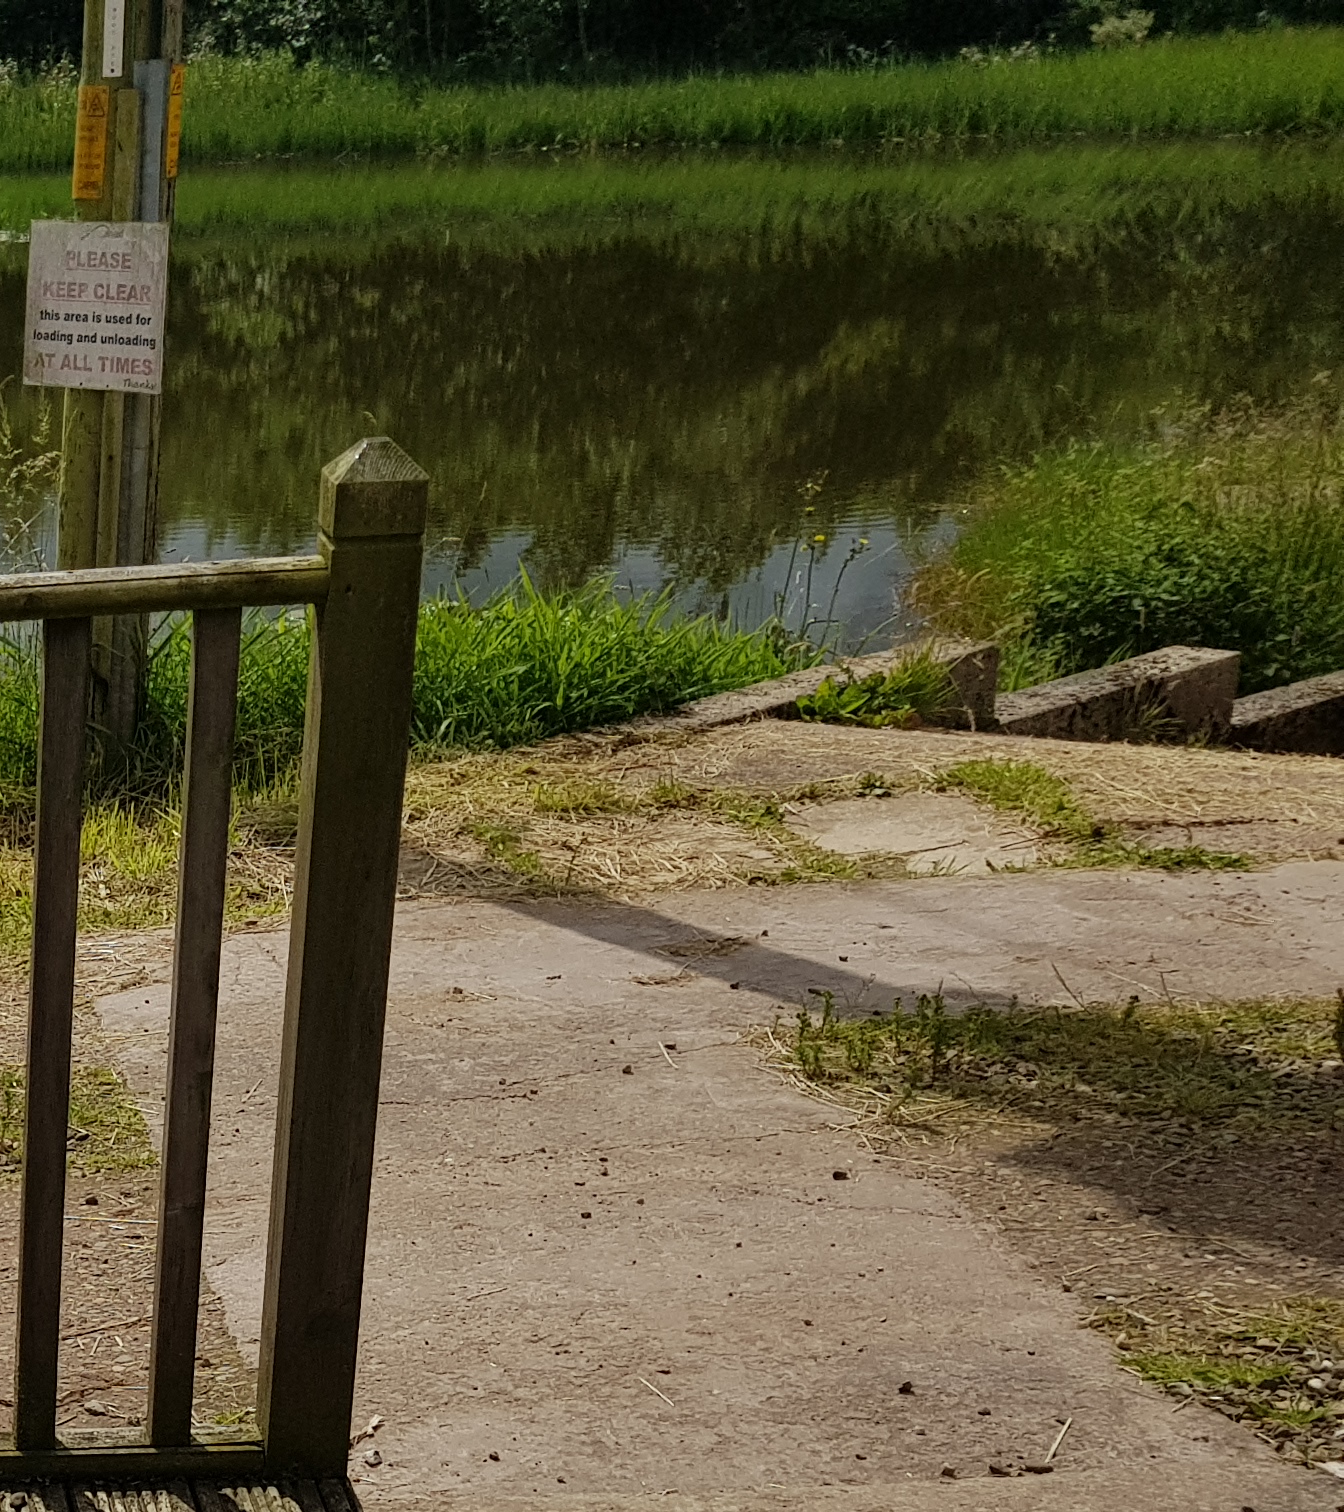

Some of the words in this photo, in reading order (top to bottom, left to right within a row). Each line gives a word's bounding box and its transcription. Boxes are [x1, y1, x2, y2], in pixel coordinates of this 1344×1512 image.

[66, 250, 132, 270] PLEASE
[42, 280, 88, 298] KEEP
[93, 283, 152, 302] CLEAR
[40, 309, 60, 321] this
[64, 312, 88, 322] area
[92, 311, 102, 323] is
[106, 314, 132, 325] used
[136, 314, 152, 325] for
[33, 329, 73, 345] loading
[77, 332, 97, 343] and
[101, 334, 156, 350] unloading
[34, 352, 56, 369] AT
[60, 353, 92, 372] ALL
[98, 356, 153, 376] TIMES
